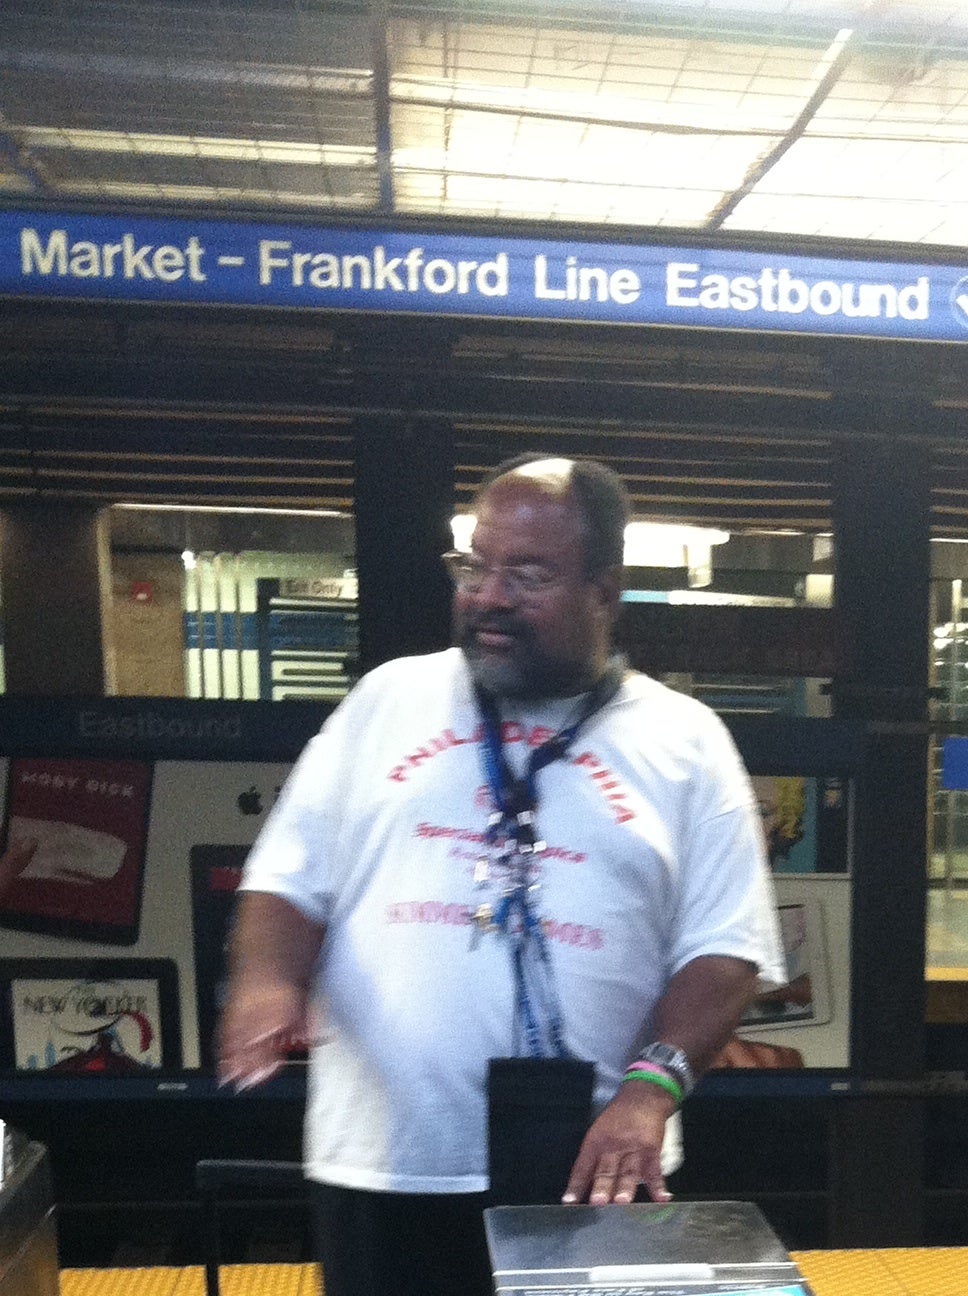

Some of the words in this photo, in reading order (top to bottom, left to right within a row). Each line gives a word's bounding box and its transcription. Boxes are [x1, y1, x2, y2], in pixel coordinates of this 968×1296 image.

[20, 228, 206, 281] Market
[258, 239, 508, 297] Frankford
[535, 255, 640, 304] Line
[666, 262, 929, 320] Eastbound
